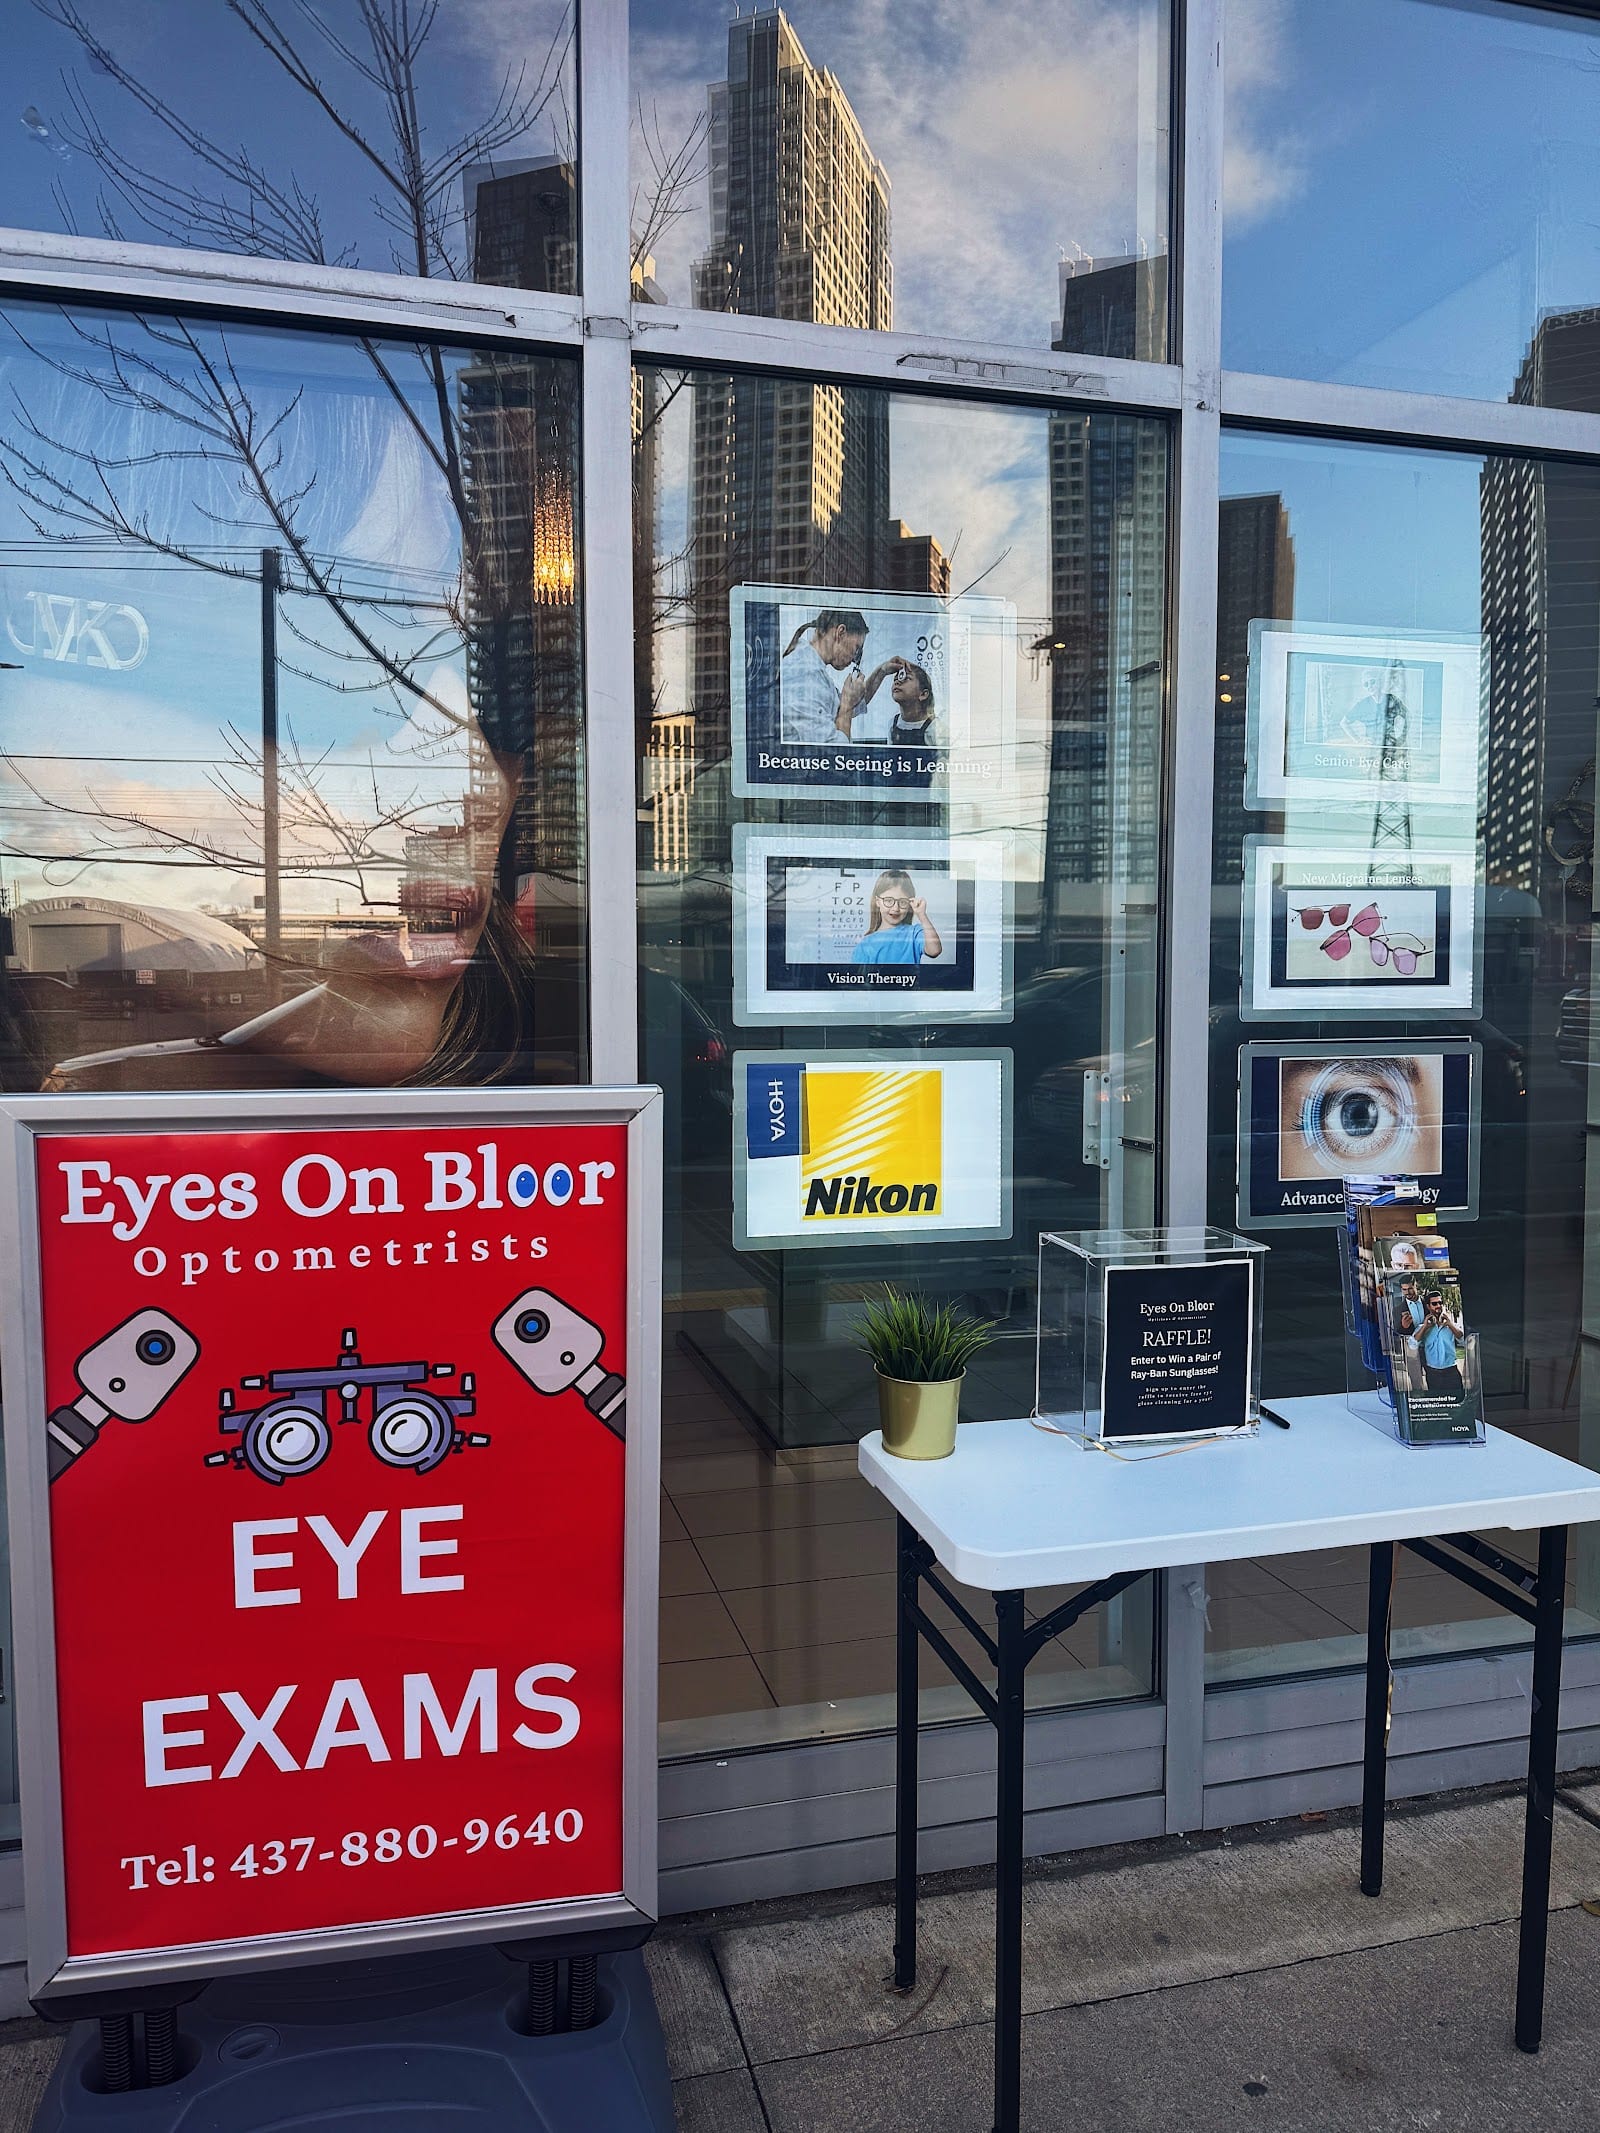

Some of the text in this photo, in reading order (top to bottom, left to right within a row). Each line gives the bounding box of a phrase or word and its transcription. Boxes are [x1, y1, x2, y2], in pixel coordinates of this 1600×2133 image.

[758, 752, 993, 779] Because Seeing is Learning
[1314, 754, 1412, 771] Senior Eye Care
[1302, 873, 1424, 887] New Migraine Lenses
[827, 972, 916, 988] Vision Therapy
[768, 1078, 786, 1142] HOYA
[58, 1142, 616, 1241] Eyes On Bloor
[804, 1176, 938, 1215] Nikon
[1280, 1190, 1343, 1206] Advance
[132, 1230, 550, 1286] Optometrists
[1140, 1300, 1215, 1317] Eyes On Bloor
[1142, 1328, 1212, 1347] RAFFLE!
[1131, 1356, 1154, 1366] Enter
[1156, 1356, 1166, 1364] to
[1168, 1354, 1186, 1364] Win
[1195, 1352, 1211, 1362] Pair
[1212, 1350, 1222, 1360] of
[1131, 1365, 1219, 1381] Ray-Ban Sunglasses!
[232, 1504, 466, 1609] EYE
[142, 1662, 582, 1788] EXAMS
[120, 1808, 584, 1891] Tel: 437-880-9640
